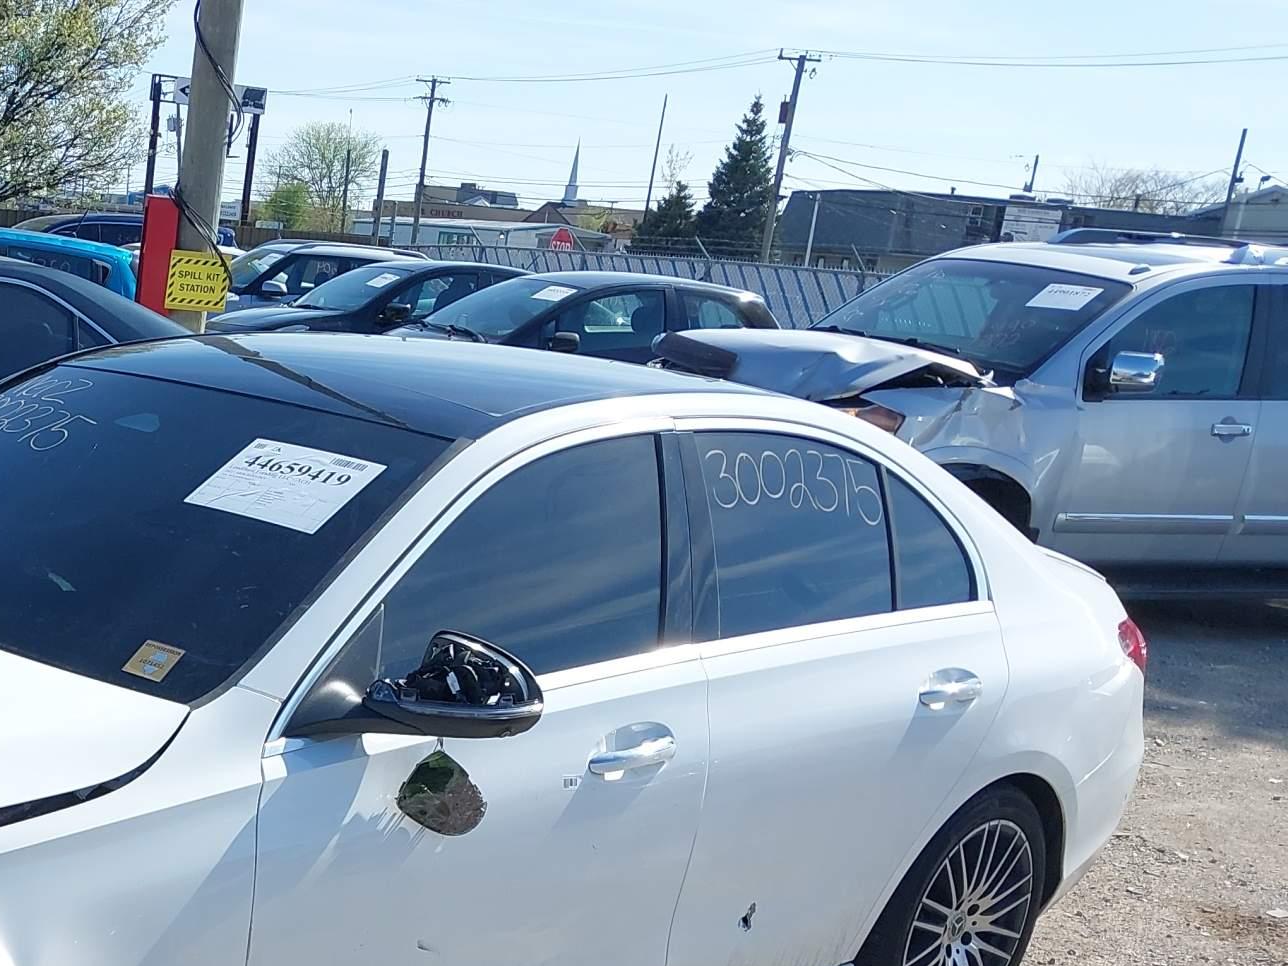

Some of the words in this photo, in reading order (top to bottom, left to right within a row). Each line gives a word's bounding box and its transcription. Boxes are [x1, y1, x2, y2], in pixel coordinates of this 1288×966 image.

[430, 208, 463, 218] CHURCH
[552, 240, 571, 251] STOP
[177, 270, 203, 281] SPILL
[206, 272, 220, 282] KIT
[179, 282, 216, 294] STATION
[244, 455, 352, 487] 44659419
[705, 448, 883, 526] 3002375
